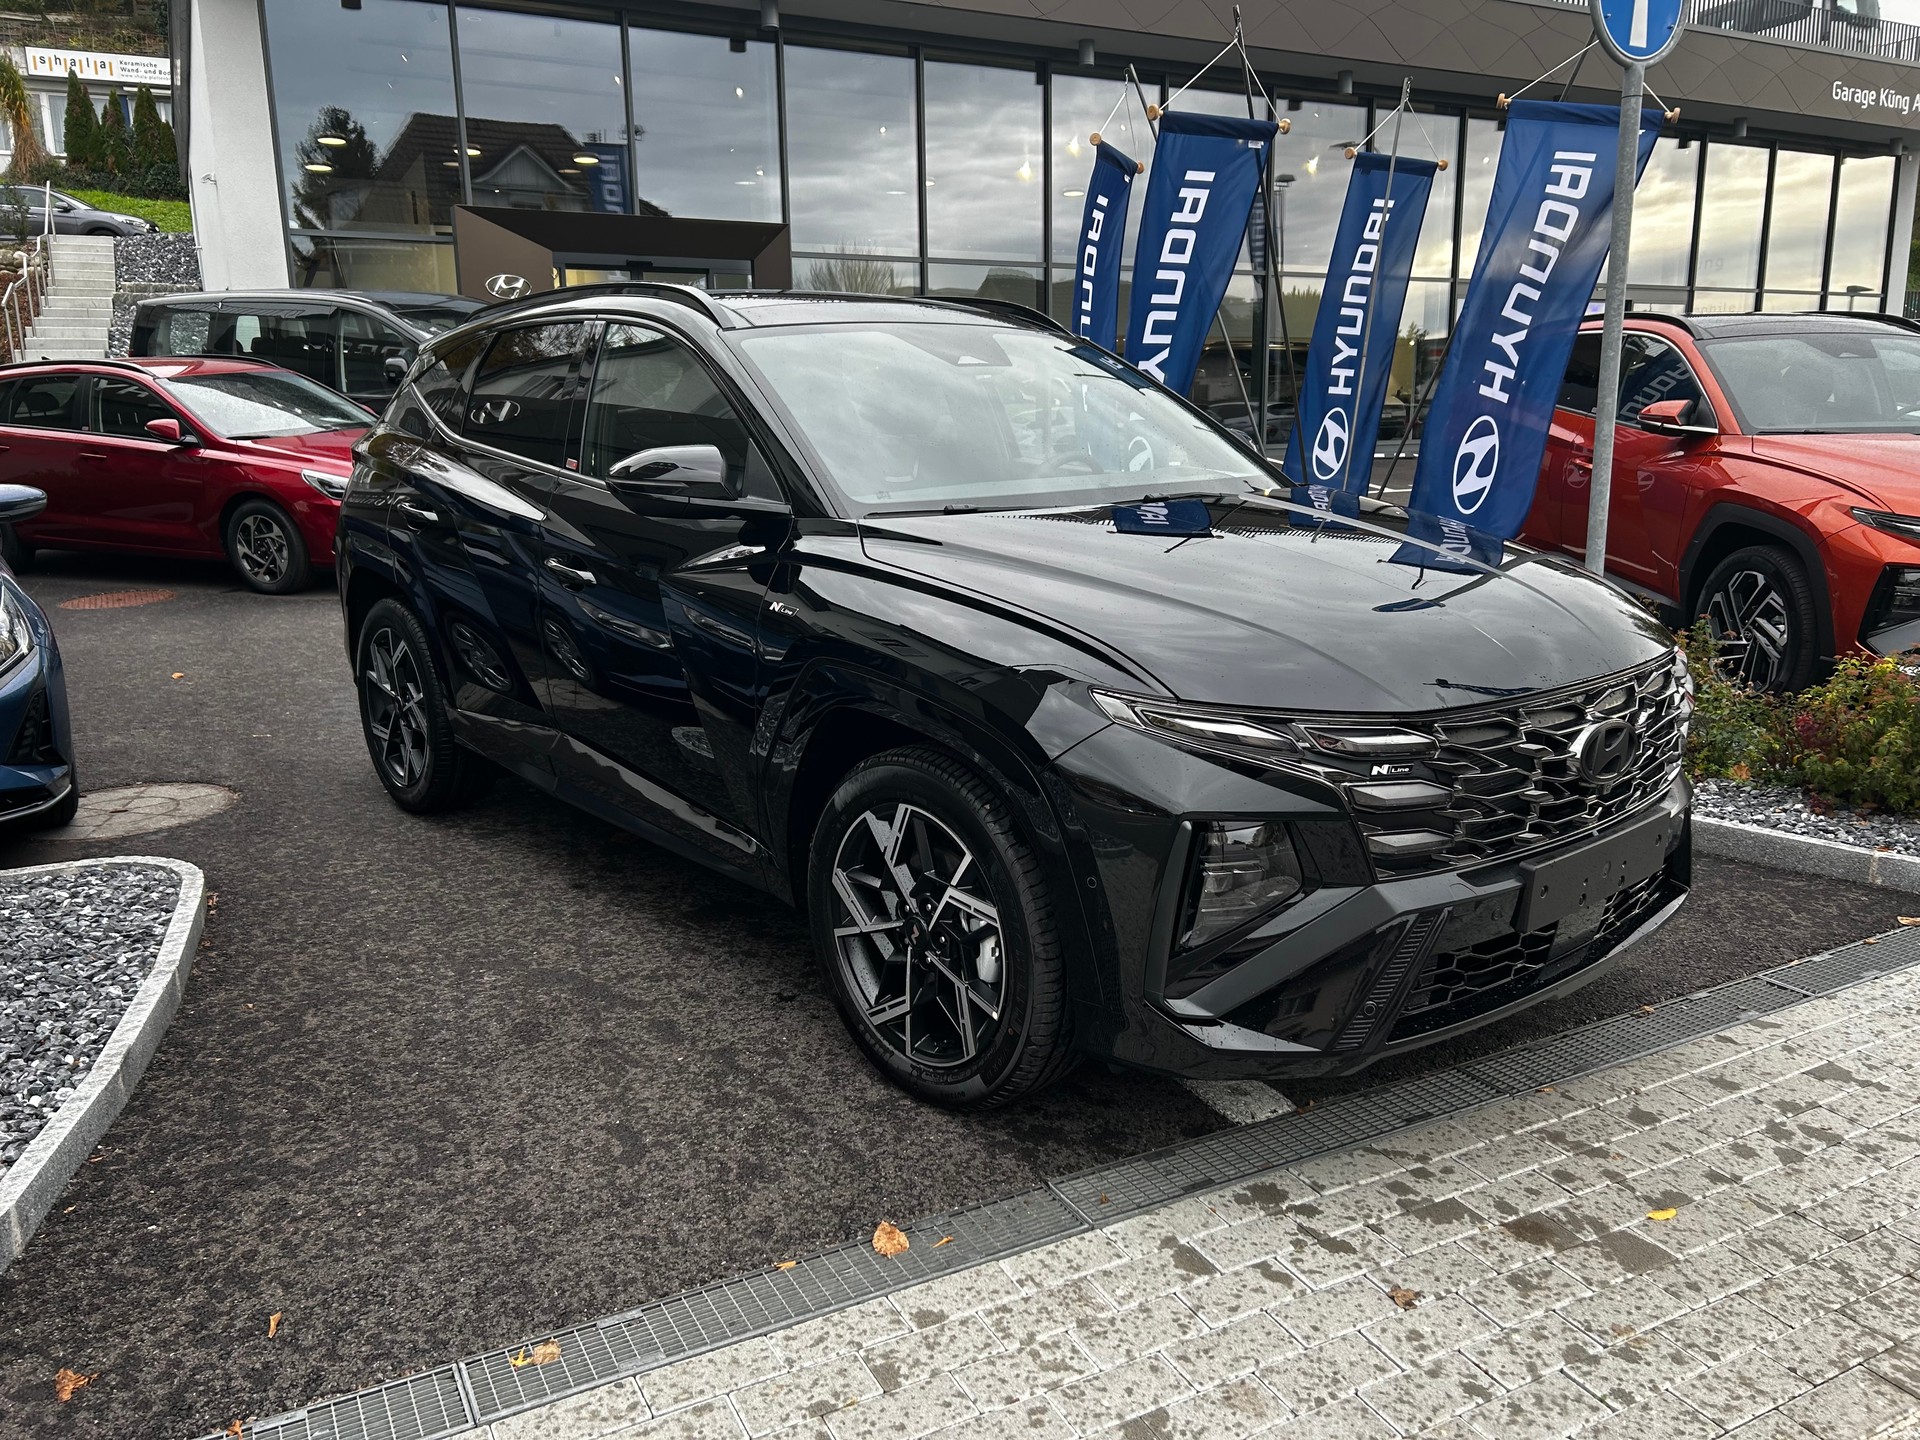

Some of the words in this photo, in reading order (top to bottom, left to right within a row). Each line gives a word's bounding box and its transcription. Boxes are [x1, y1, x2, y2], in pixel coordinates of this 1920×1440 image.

[119, 59, 158, 68] Keramische
[1832, 80, 1877, 109] Garage
[1879, 87, 1911, 115] Küng
[1327, 198, 1396, 396] HYUNDAI
[1371, 764, 1389, 775] N
